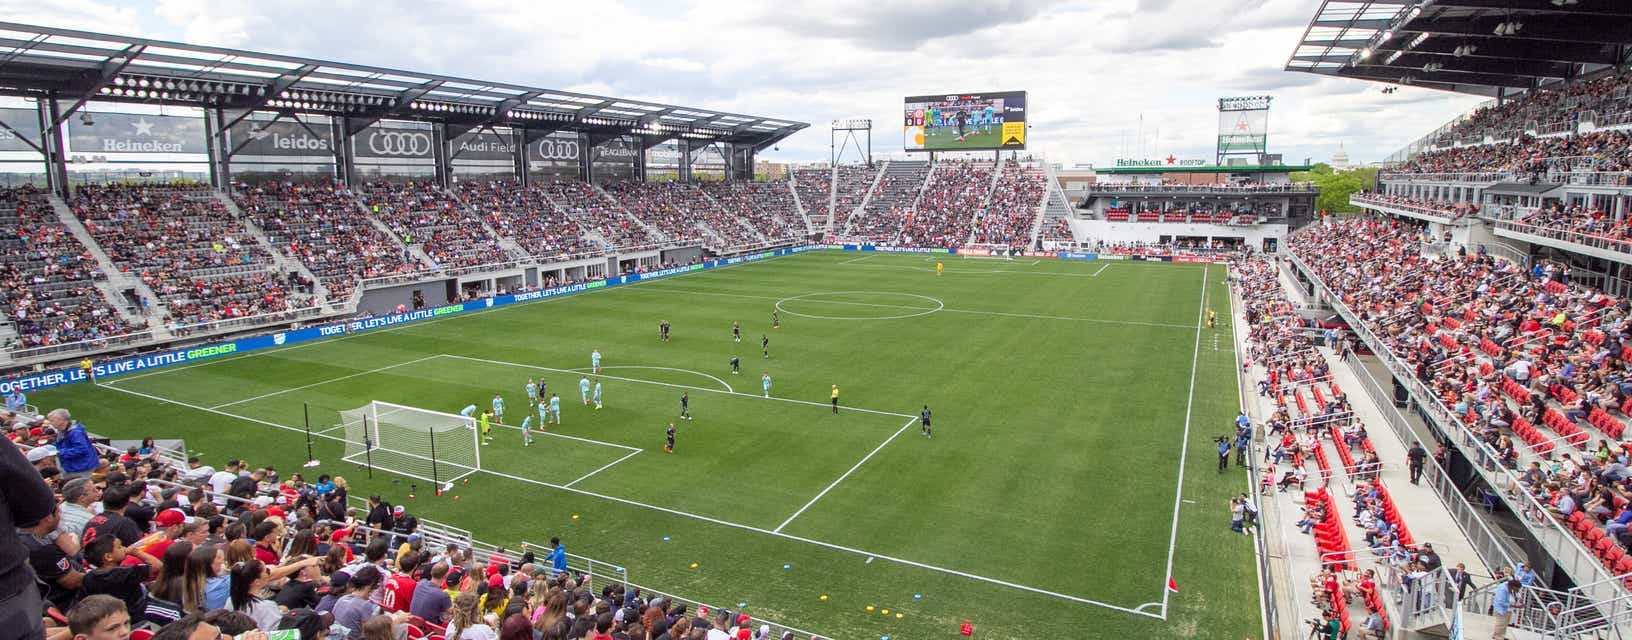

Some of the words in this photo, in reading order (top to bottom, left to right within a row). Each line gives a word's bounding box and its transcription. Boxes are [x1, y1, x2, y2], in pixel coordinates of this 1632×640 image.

[103, 138, 182, 152] Heineken
[273, 132, 328, 150] leidos
[460, 141, 488, 152] Audi
[490, 142, 516, 153] Field
[1116, 158, 1162, 166] Heineken
[365, 317, 386, 329] LET'S
[387, 313, 403, 325] LIVE
[403, 313, 410, 321] A
[410, 309, 433, 321] LITTLE
[70, 364, 106, 381] LE'S
[108, 360, 136, 374] LIVE
[136, 359, 146, 369] A
[146, 351, 186, 367] LITTLE
[187, 343, 237, 360] GREENER
